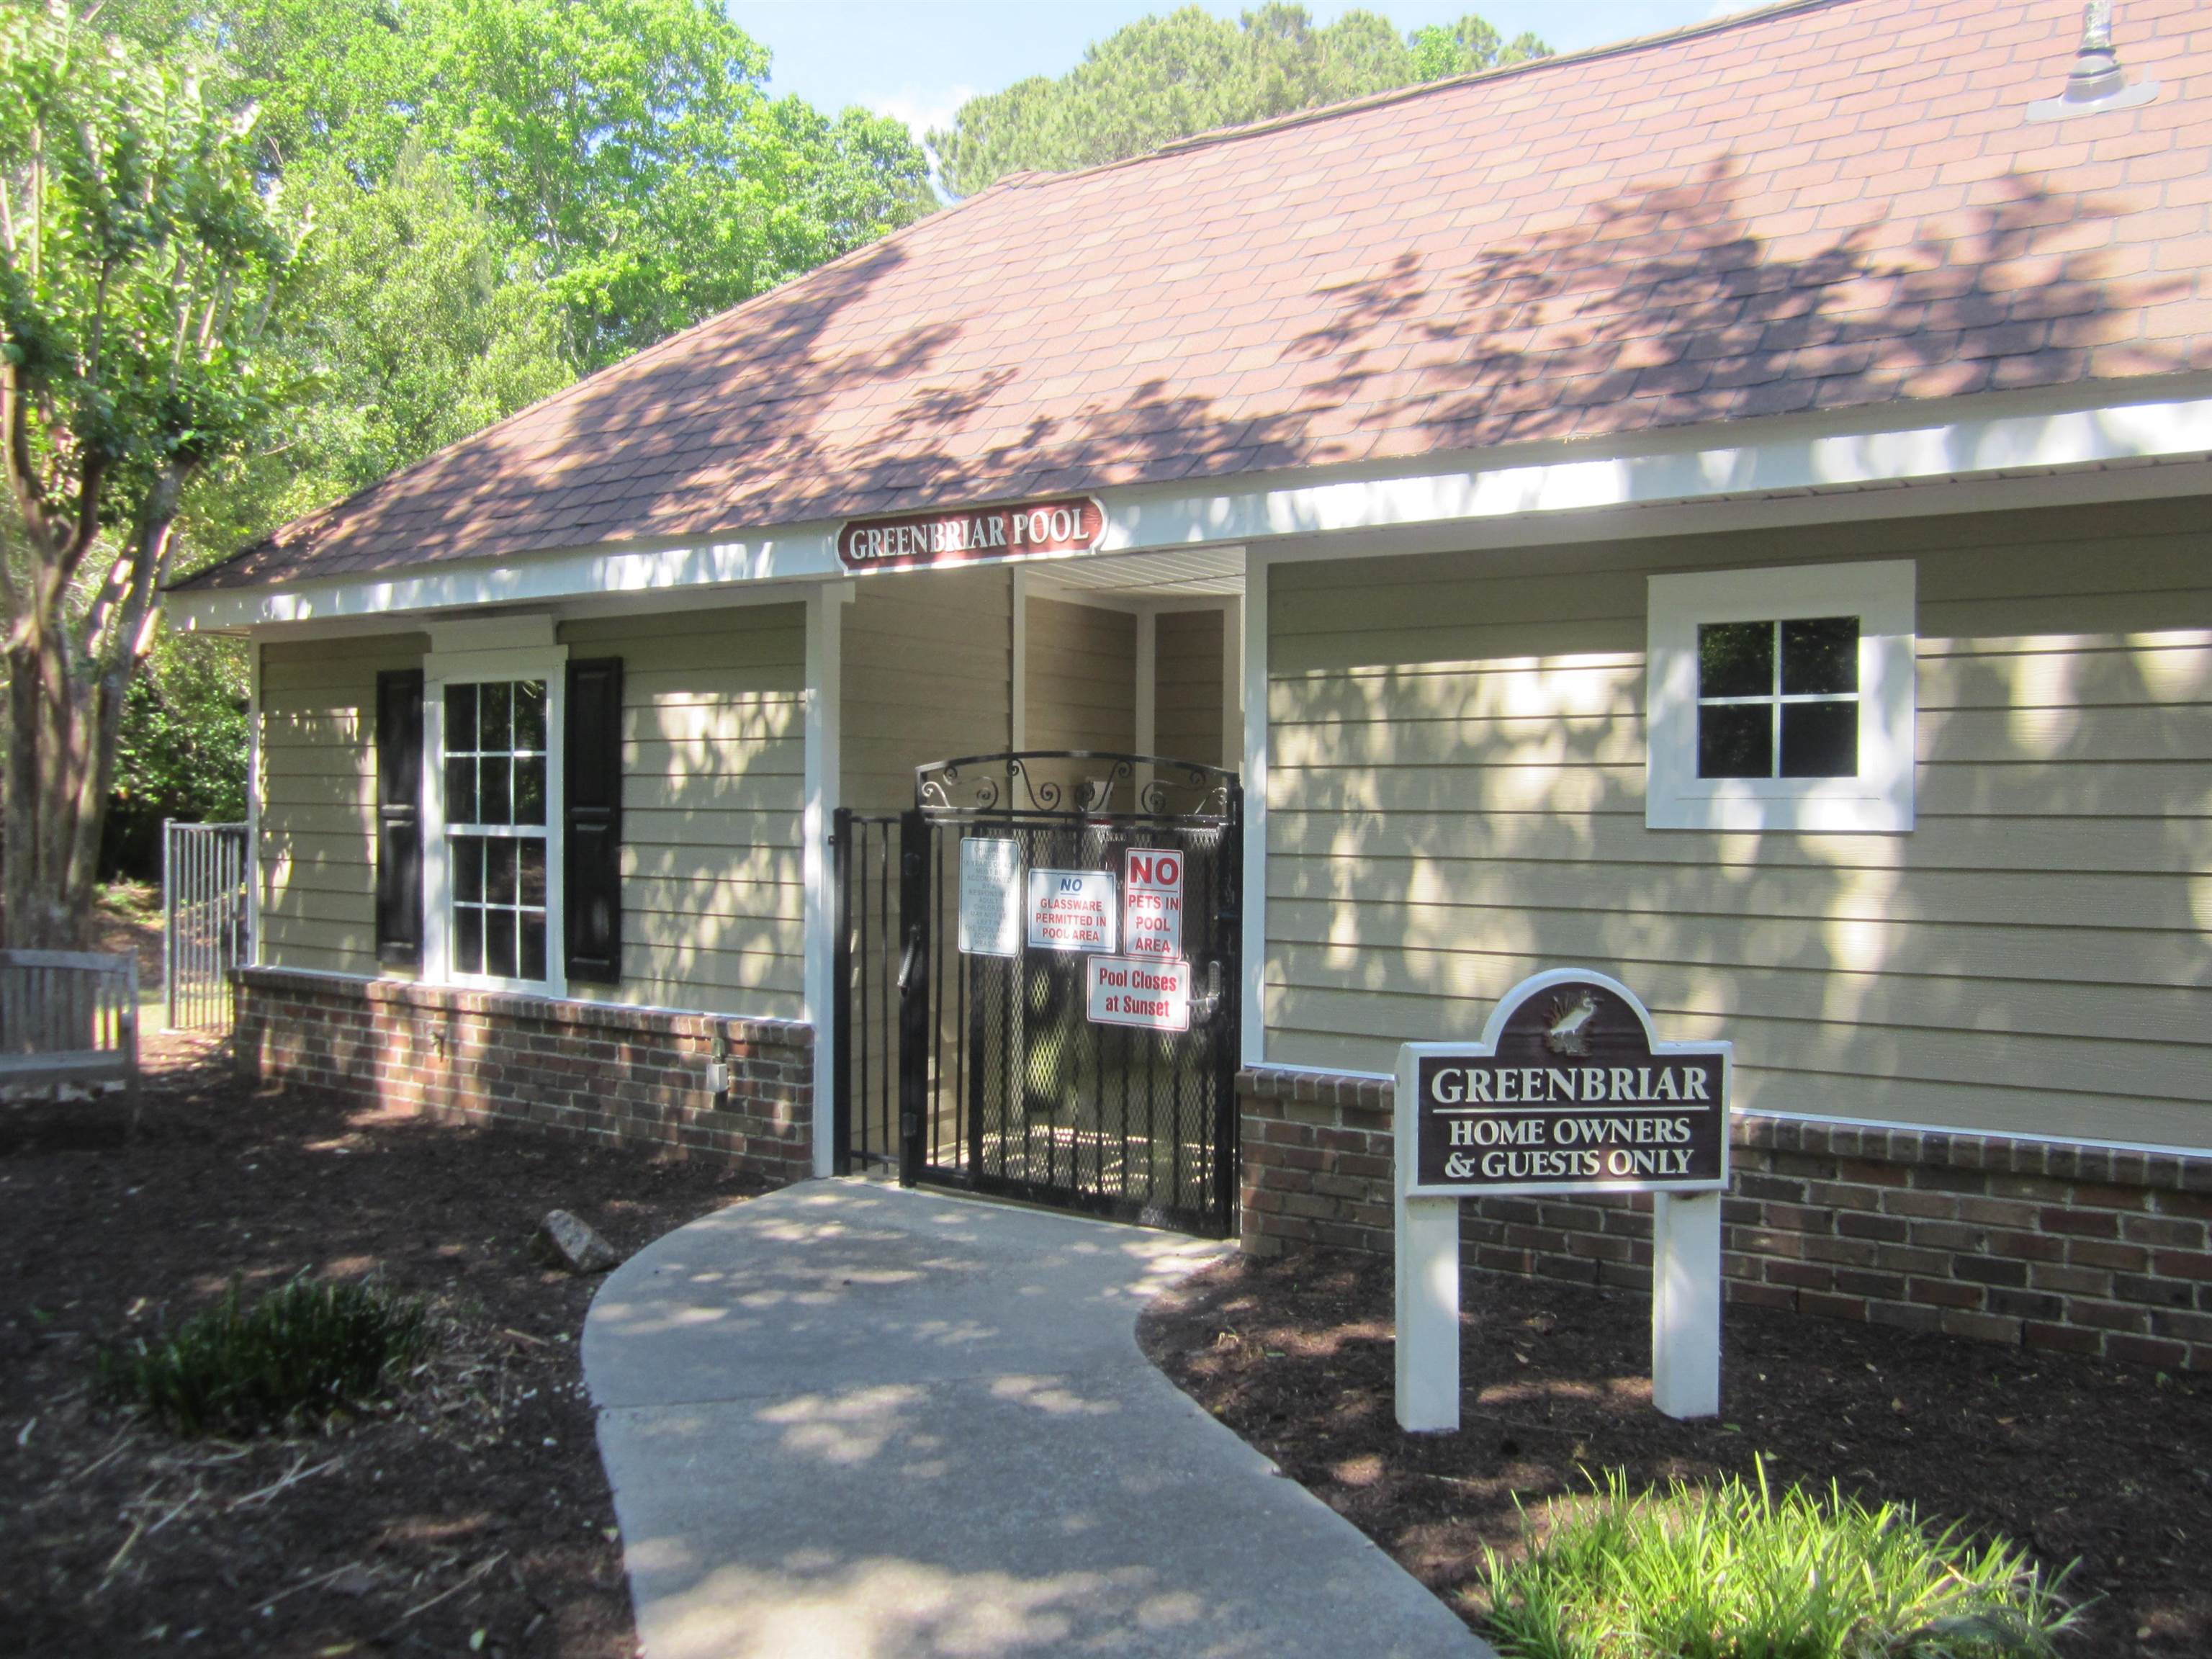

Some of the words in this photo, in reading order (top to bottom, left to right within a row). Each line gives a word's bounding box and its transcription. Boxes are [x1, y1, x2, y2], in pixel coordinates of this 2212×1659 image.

[849, 516, 1006, 559] GREENBRIAR
[1012, 508, 1089, 545] POOL
[1130, 855, 1179, 886] NO
[1060, 878, 1082, 891] NO
[1040, 898, 1102, 912] GLASSWARE
[1128, 894, 1161, 909] PETS
[1166, 897, 1179, 911] IN
[1035, 913, 1093, 926] PERMITTED
[1097, 916, 1107, 927] IN
[1136, 916, 1171, 932] POOL
[1042, 927, 1069, 940] POOL
[1072, 930, 1100, 942] AREA
[1135, 938, 1171, 953] AREA
[1099, 967, 1128, 987] Pool
[1132, 970, 1177, 992] Closes
[1105, 995, 1119, 1012] at
[1123, 995, 1169, 1017] Sunset
[1431, 1066, 1710, 1103] GREENBRIAR
[1448, 1118, 1546, 1146] HOME
[1553, 1117, 1691, 1145] OWNERS
[1444, 1152, 1475, 1179] &
[1481, 1149, 1601, 1178] GUESTS
[1607, 1148, 1694, 1176] ONLY
